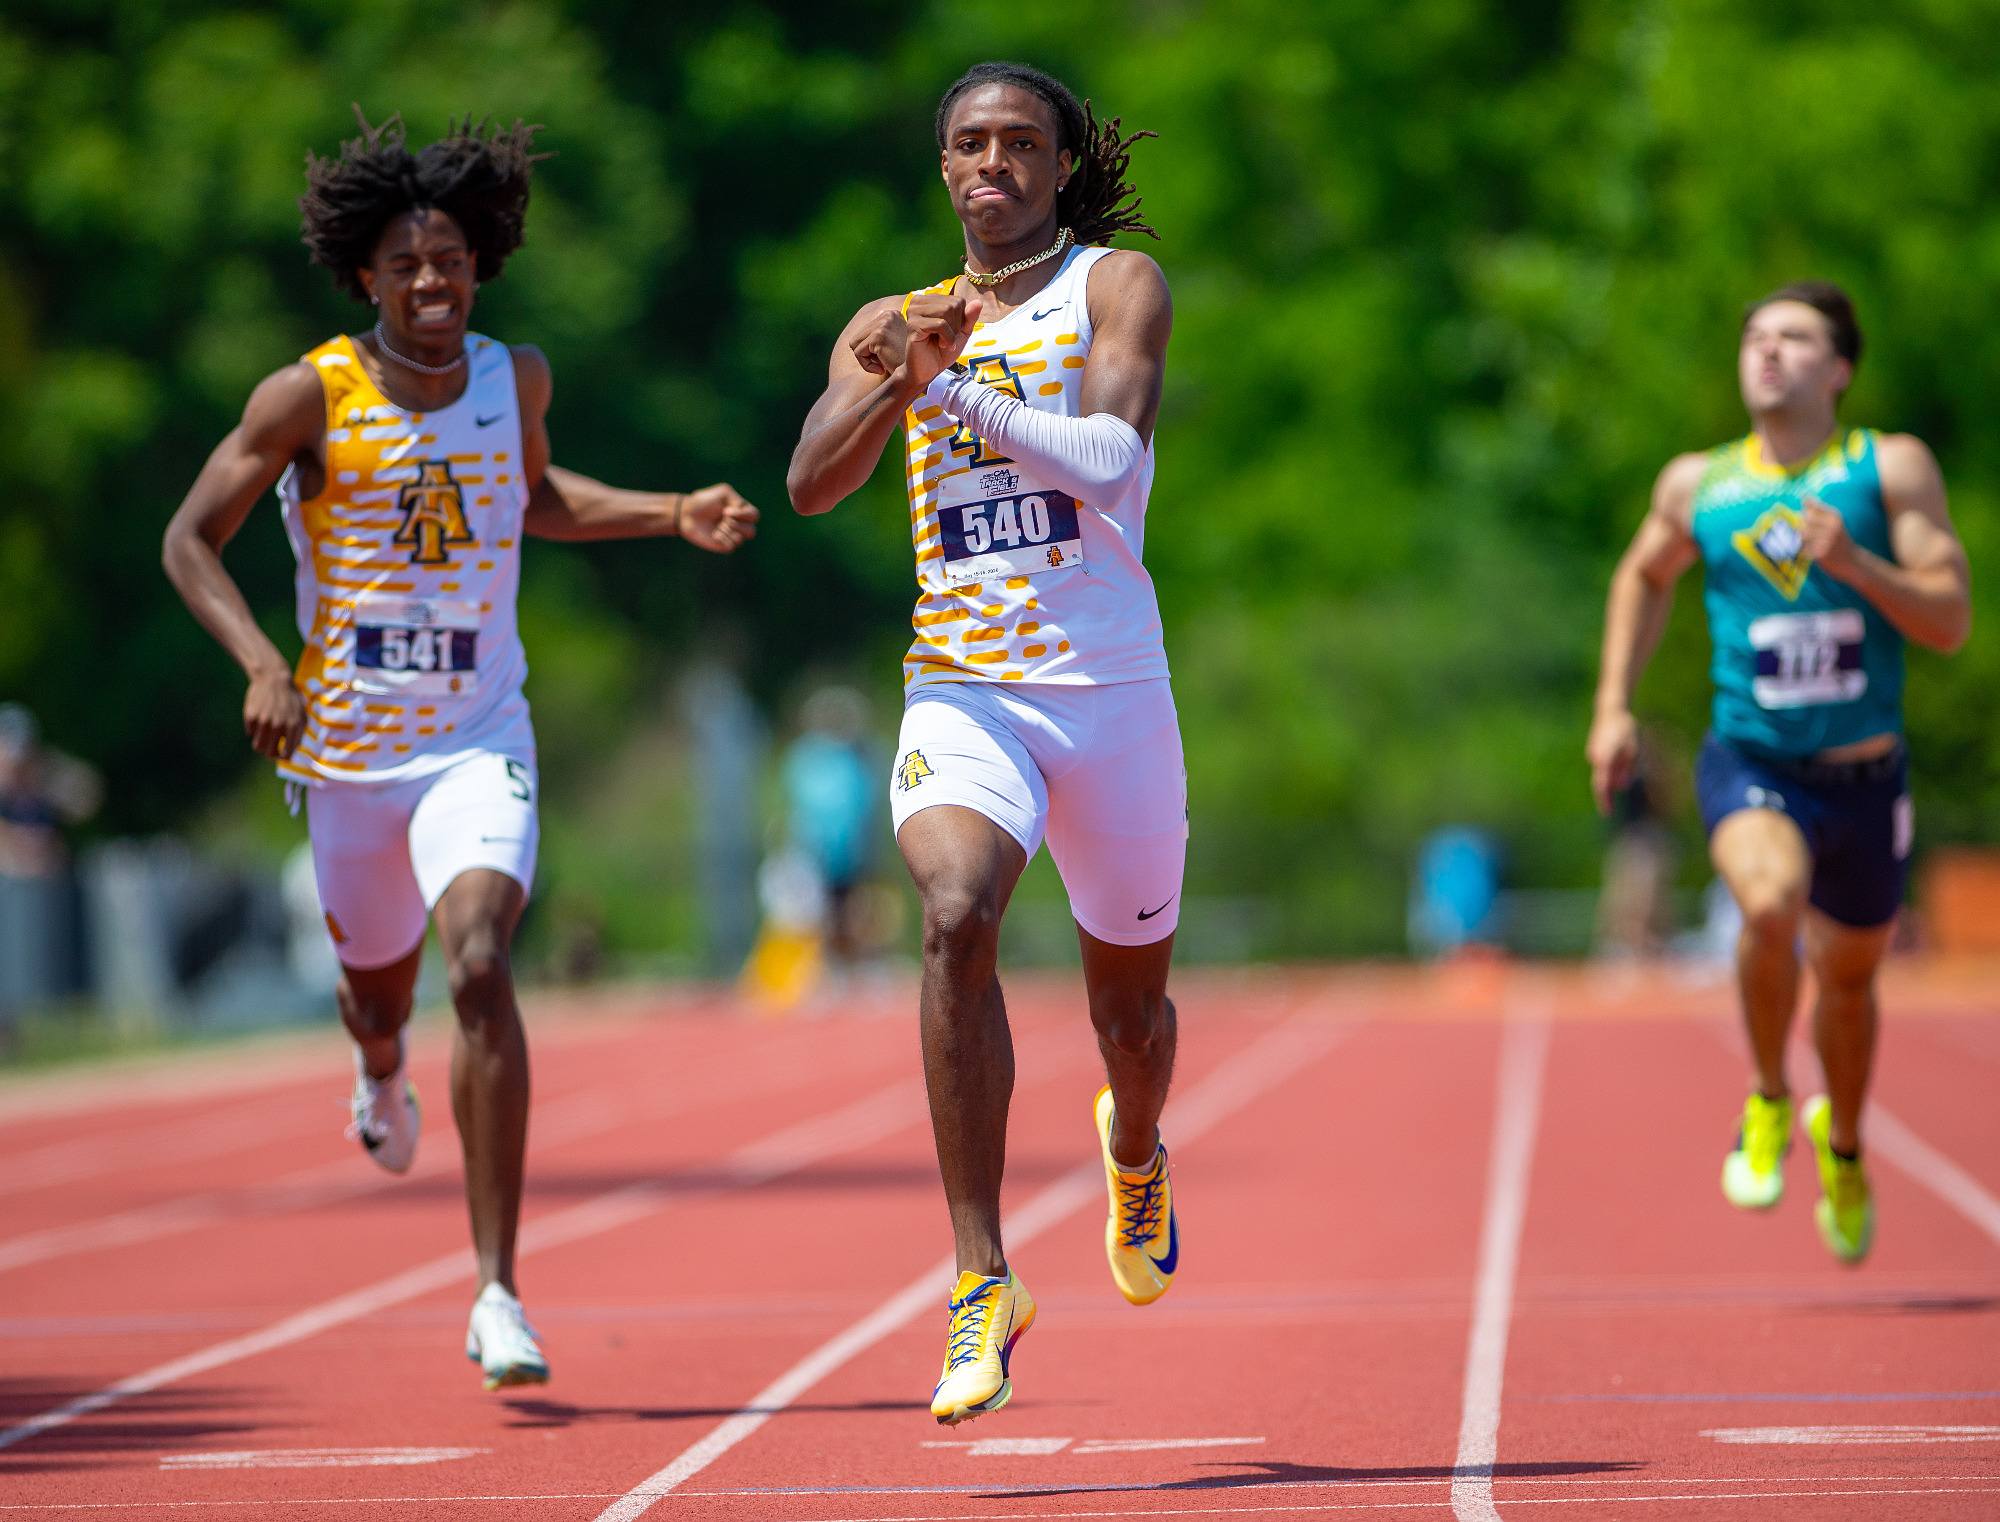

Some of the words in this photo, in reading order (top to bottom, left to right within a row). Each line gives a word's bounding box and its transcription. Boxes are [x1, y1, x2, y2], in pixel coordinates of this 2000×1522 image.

[980, 476, 1009, 489] TRACK
[987, 482, 1017, 497] FIELD
[962, 495, 1051, 553] 540
[381, 628, 453, 671] 541
[505, 758, 529, 801] 5
